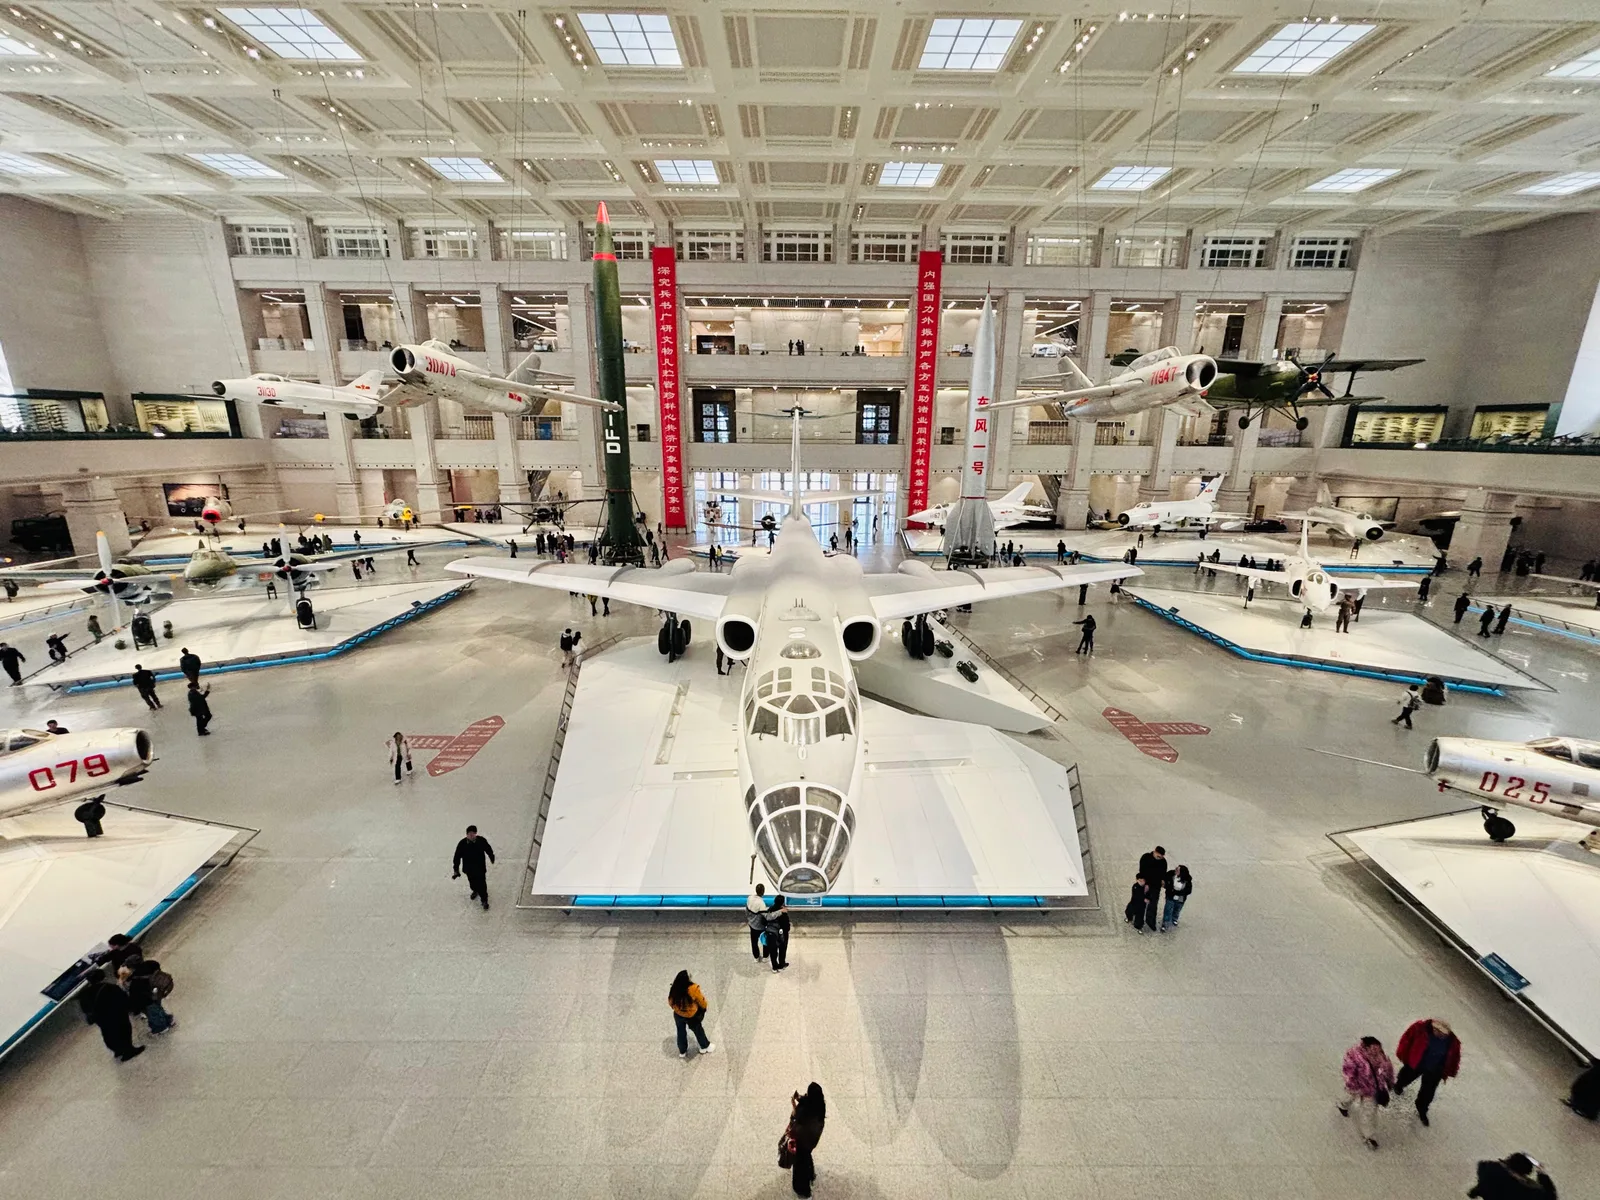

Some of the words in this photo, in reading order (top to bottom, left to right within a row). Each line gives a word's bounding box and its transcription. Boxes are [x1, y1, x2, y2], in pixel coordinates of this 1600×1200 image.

[425, 355, 457, 378] 30474
[1150, 366, 1178, 386] 71947
[28, 753, 110, 791] 079
[1478, 771, 1551, 804] 025
